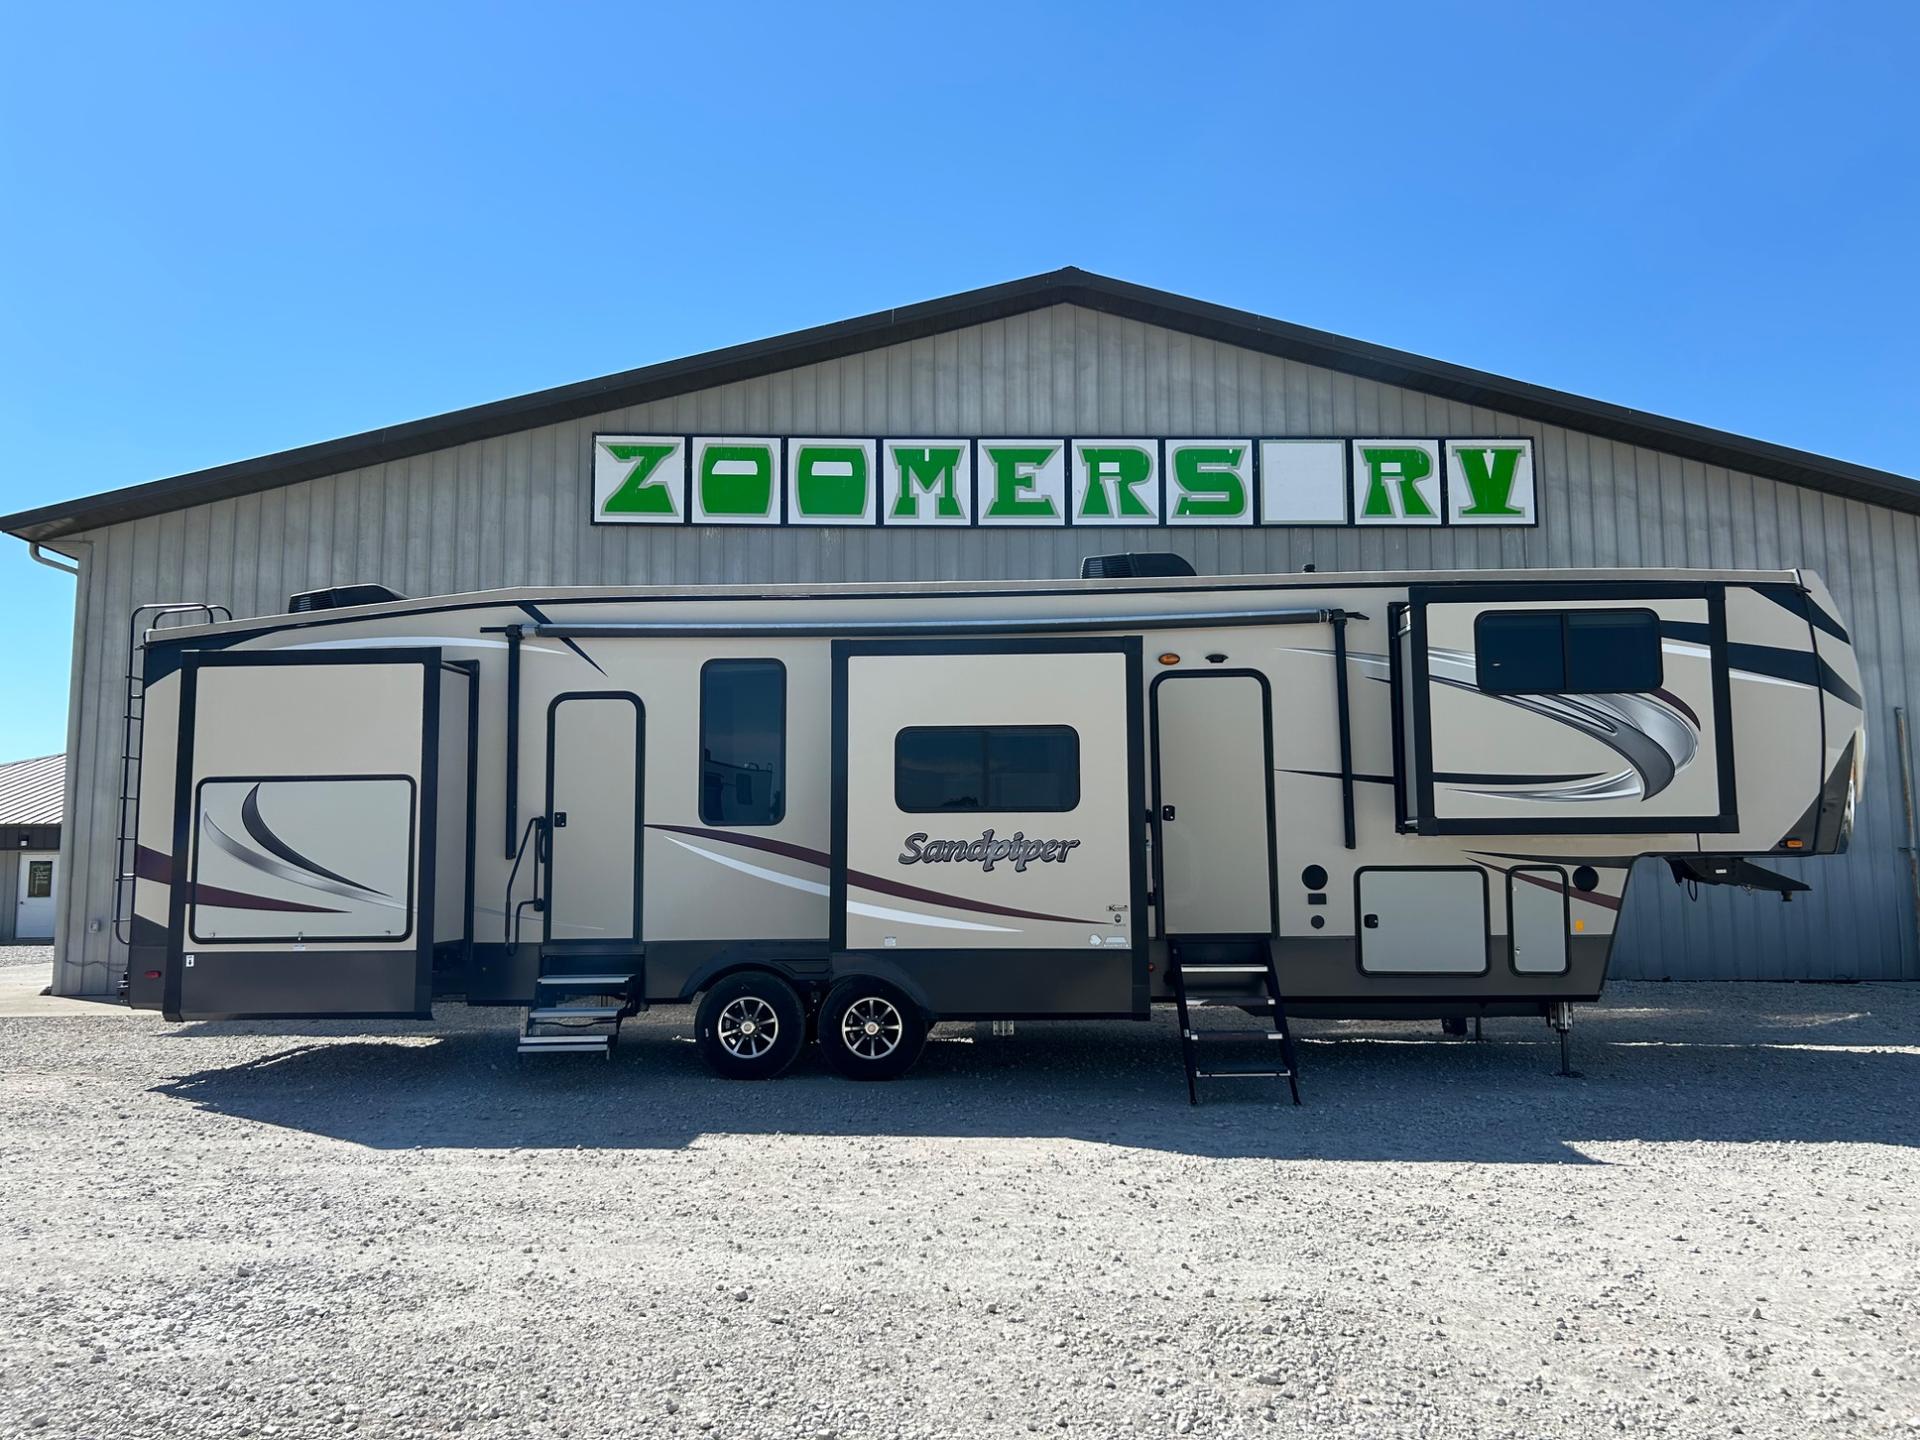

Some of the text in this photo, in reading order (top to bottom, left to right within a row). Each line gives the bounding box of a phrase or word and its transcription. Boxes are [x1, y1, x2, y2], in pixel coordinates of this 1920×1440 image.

[599, 443, 1528, 517] ZOOMERS RV
[899, 829, 1080, 872] Sandpiper
